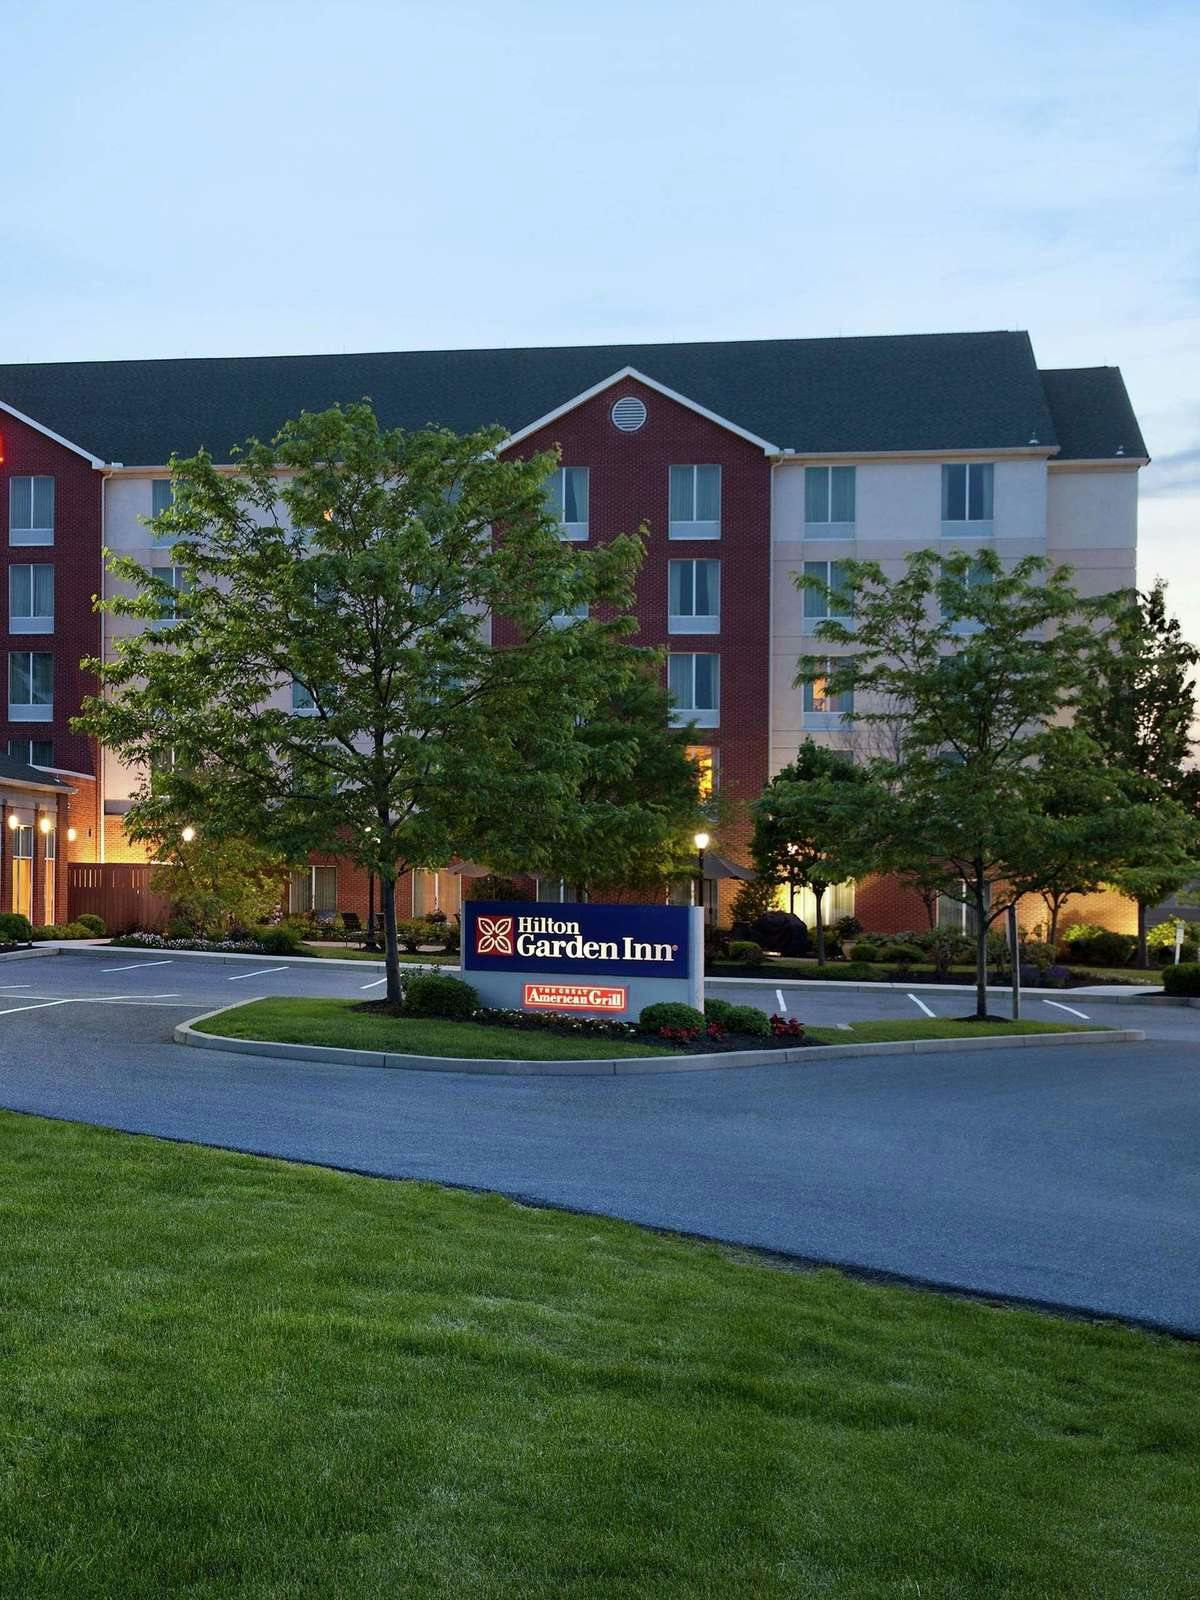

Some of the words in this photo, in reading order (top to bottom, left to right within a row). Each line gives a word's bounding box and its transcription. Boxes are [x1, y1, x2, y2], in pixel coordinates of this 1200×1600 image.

[517, 916, 580, 935] Hilton
[516, 933, 620, 960] Garden
[622, 937, 675, 962] Inn
[528, 987, 588, 1005] American
[588, 990, 621, 1006] Grill
